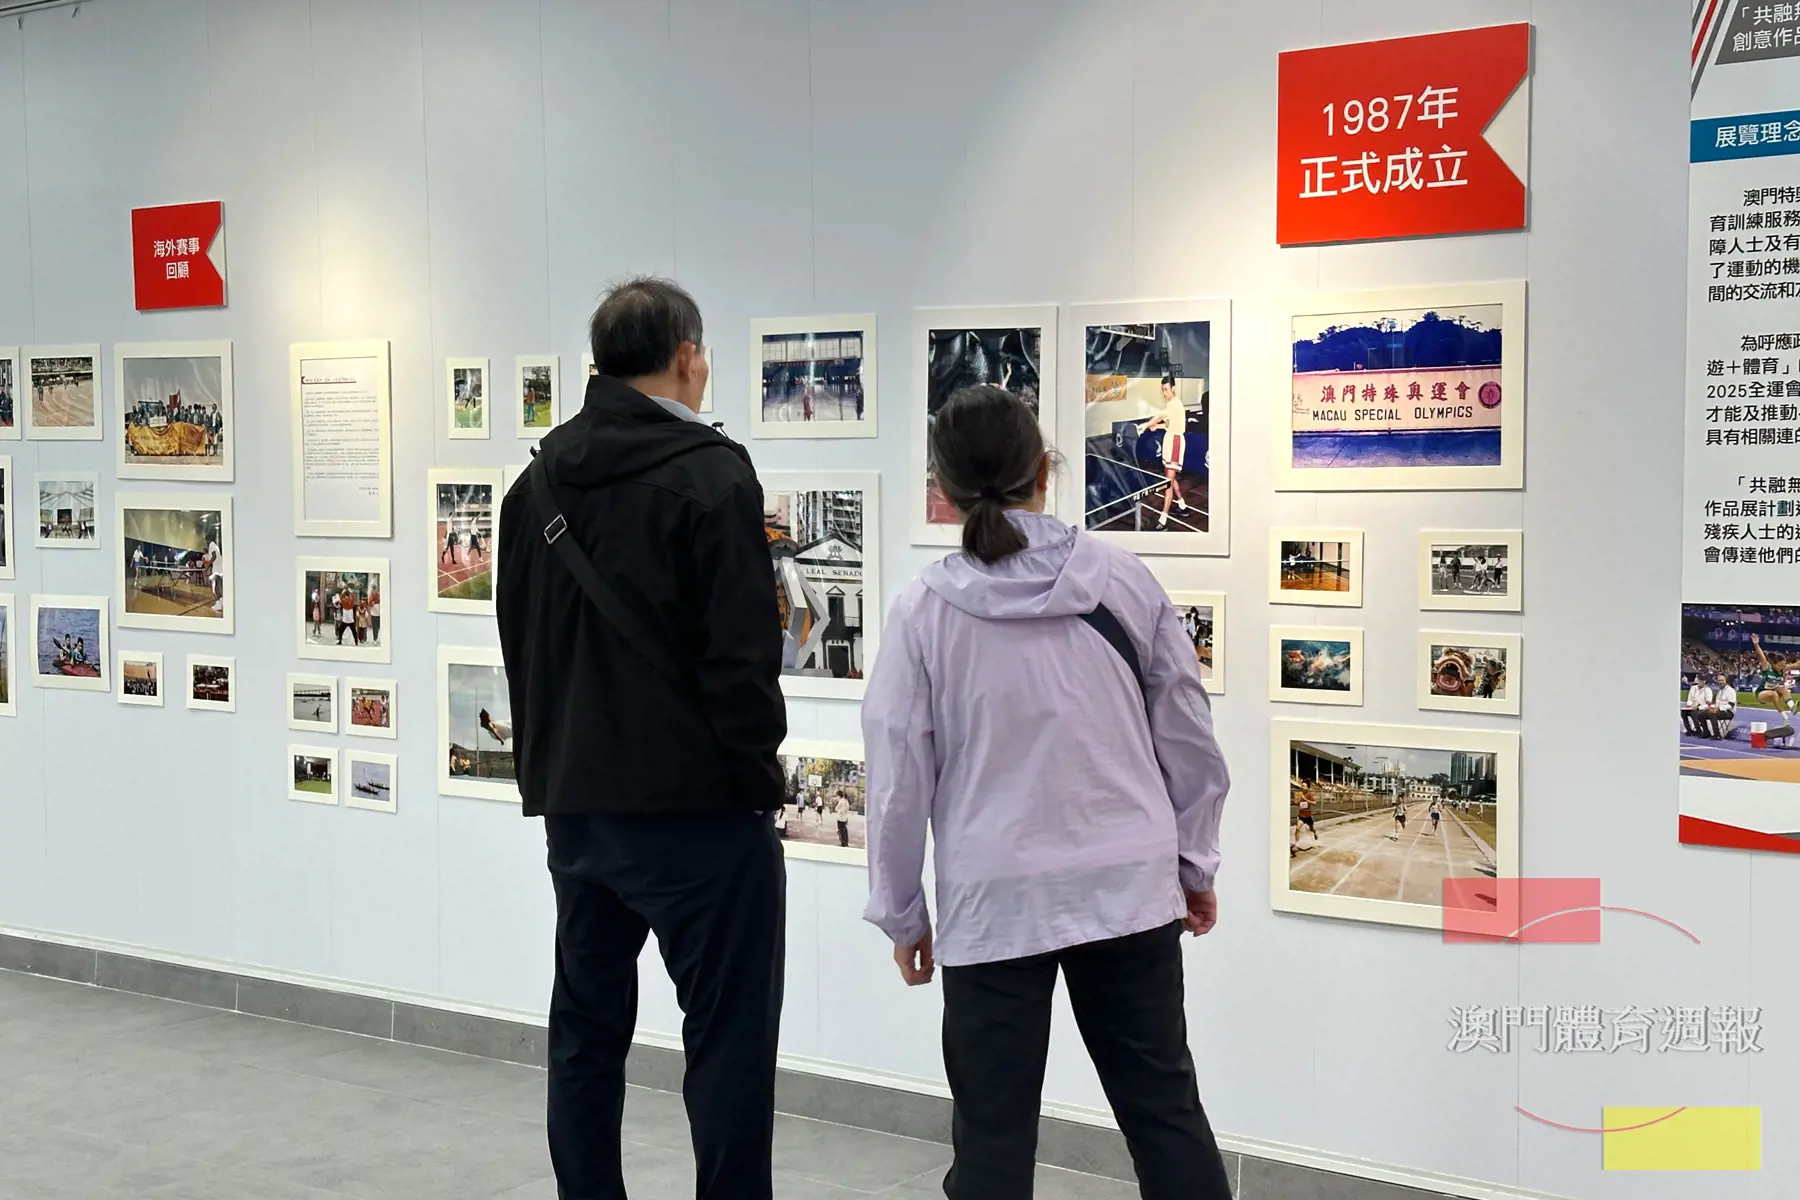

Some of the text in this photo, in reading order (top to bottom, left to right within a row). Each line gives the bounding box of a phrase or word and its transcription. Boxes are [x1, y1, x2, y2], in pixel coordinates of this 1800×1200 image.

[1322, 85, 1459, 137] 1987年
[1715, 120, 1800, 147] 展覽理念
[1299, 143, 1468, 199] 正式成立
[1743, 186, 1800, 206] 澳門特
[1709, 209, 1800, 233] 育訓練服務
[153, 237, 200, 258] 海外賽事
[1709, 233, 1800, 256] 障人士及有
[166, 261, 190, 280] 回顧
[1709, 256, 1800, 279] 了運動的機
[1708, 281, 1800, 303] 間的交流和
[1320, 381, 1471, 403] 澳門特殊奧運會
[1707, 379, 1800, 399] 2025全運會
[1312, 406, 1473, 421] MACAU SPECIAL OLYMPICS
[1704, 500, 1800, 517] 作品展計劃
[1704, 523, 1800, 540] 殘疾人士的
